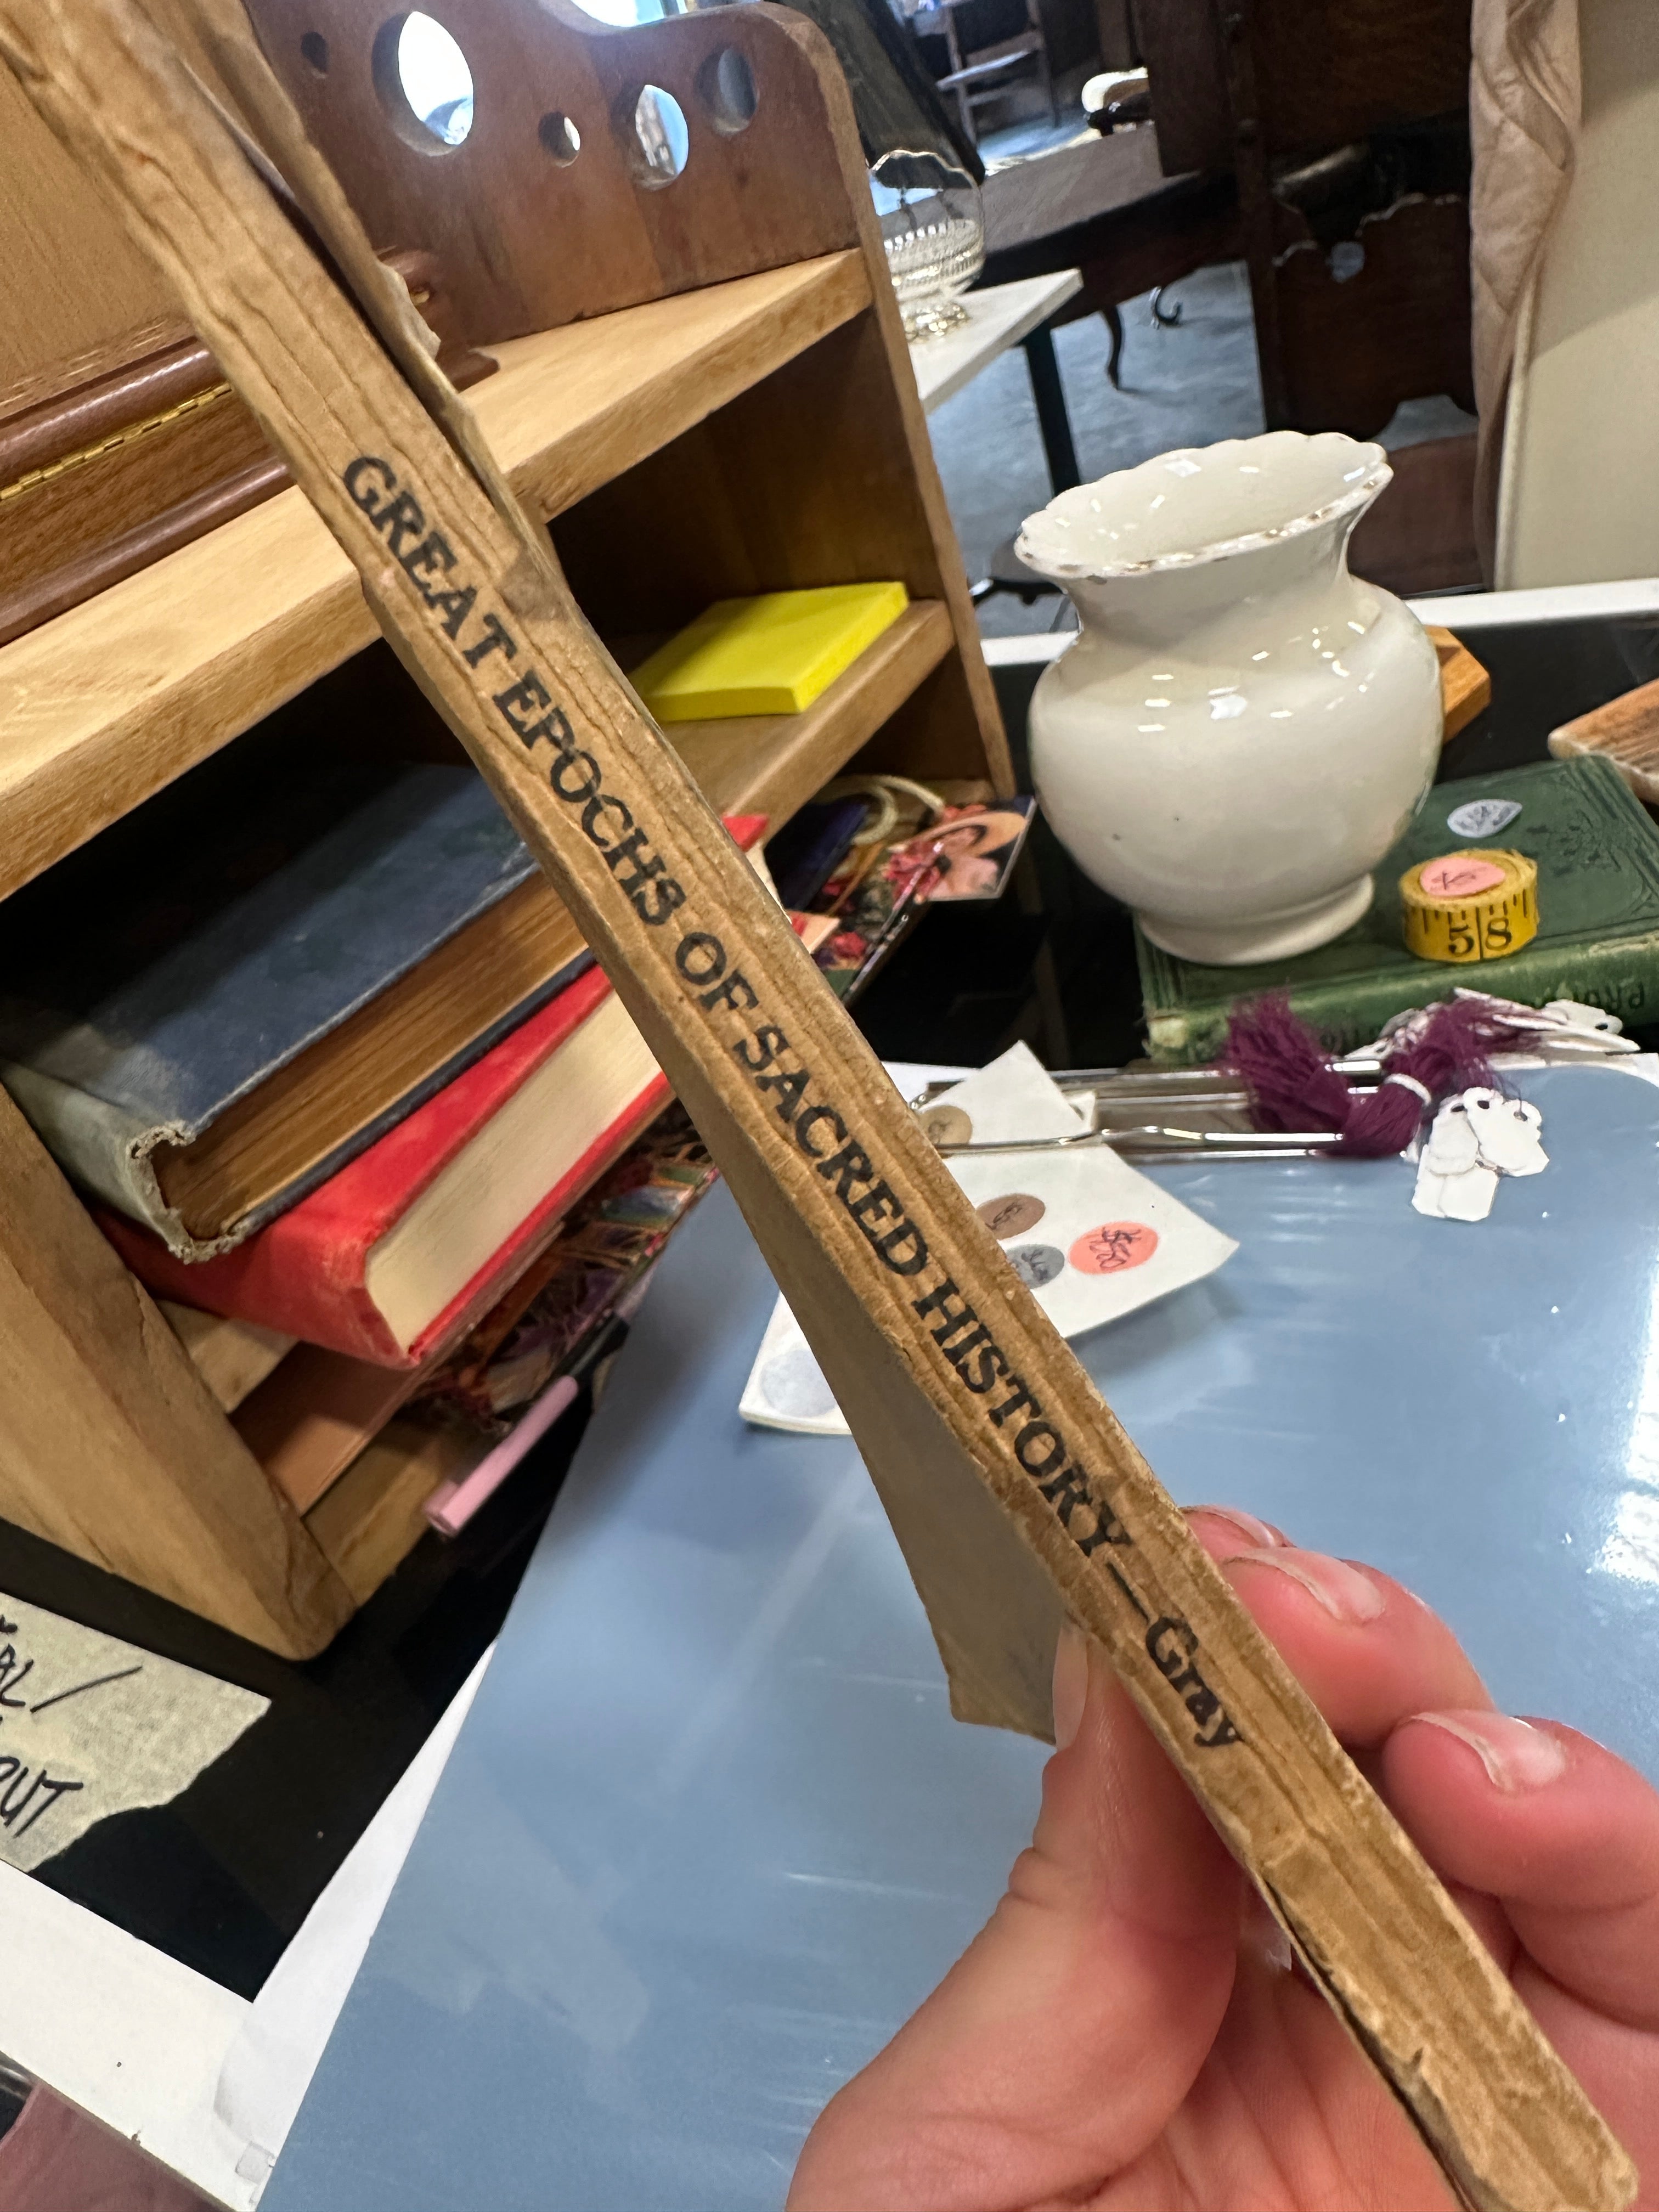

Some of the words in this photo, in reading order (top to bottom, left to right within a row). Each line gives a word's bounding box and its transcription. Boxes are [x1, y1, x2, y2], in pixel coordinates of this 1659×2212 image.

[344, 456, 517, 669] GREAT
[493, 668, 687, 926] EPOCHS
[675, 932, 759, 1011] OF
[732, 1025, 929, 1276] SACRED
